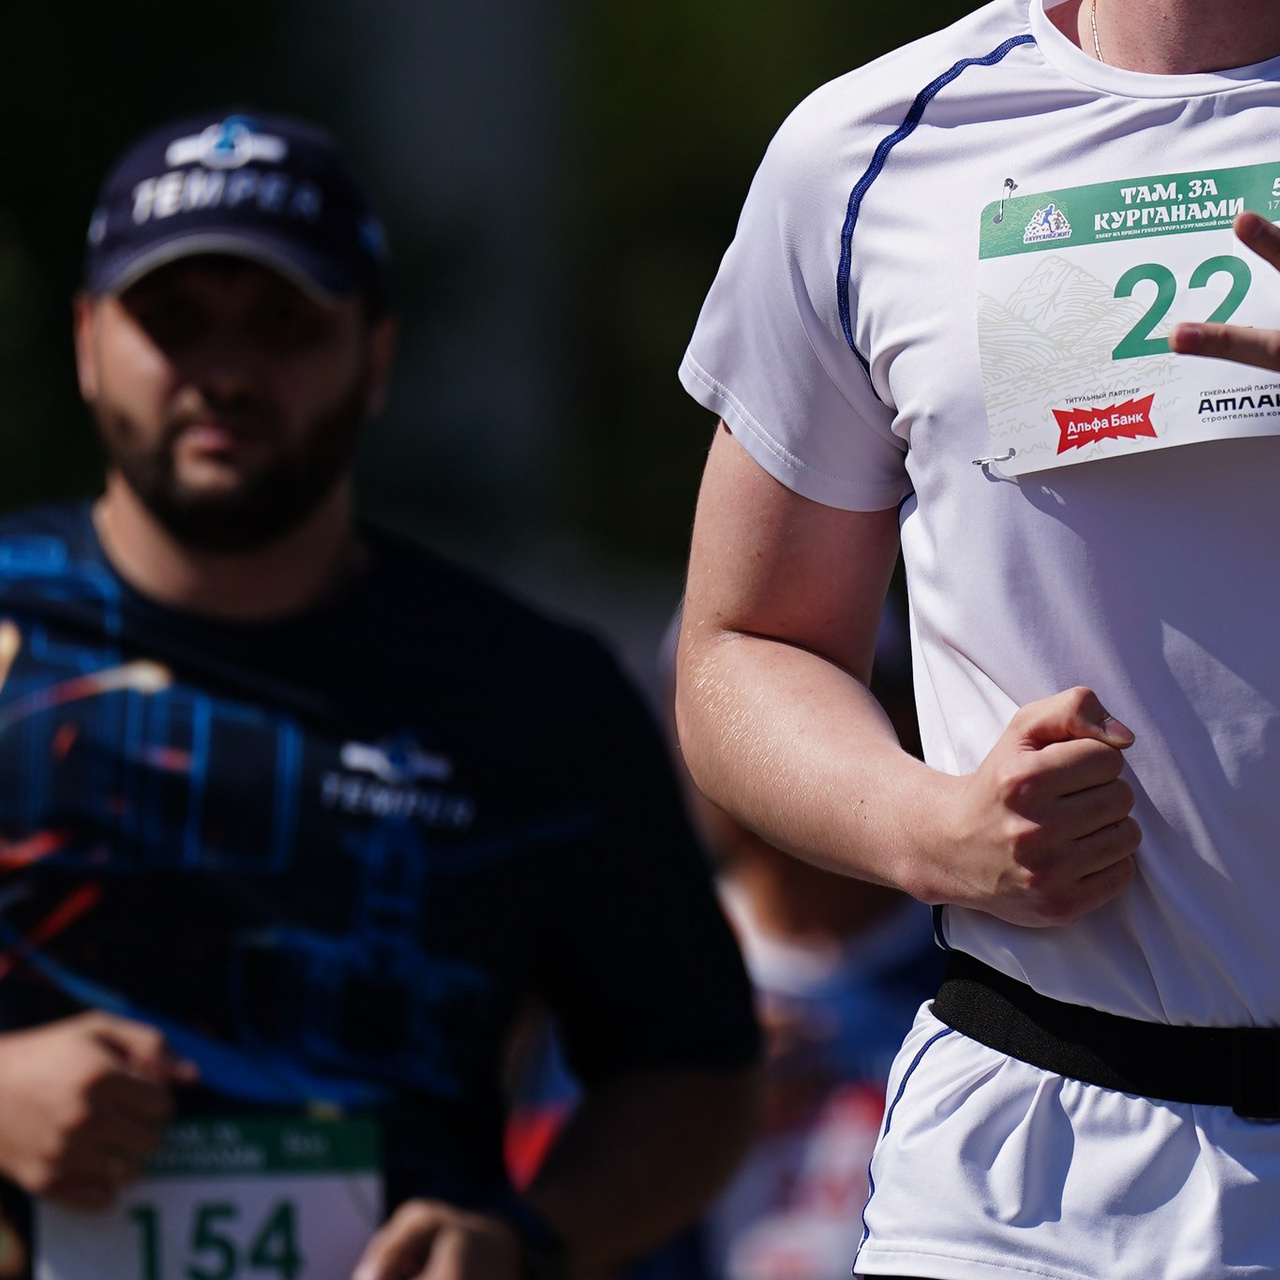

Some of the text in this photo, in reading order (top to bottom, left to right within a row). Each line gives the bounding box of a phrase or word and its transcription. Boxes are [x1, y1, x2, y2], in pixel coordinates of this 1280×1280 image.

[1120, 179, 1218, 205] ТАМ, ЗА
[1094, 197, 1245, 231] КУРГАНАМИ
[1112, 255, 1252, 360] 22
[1065, 387, 1141, 404] ТИТУЛЬНЫЙ ПАРТНЕР
[1200, 385, 1253, 397] ГЕНЕРАЛЬНЫЙ
[1067, 412, 1144, 435] Альфа Банк
[1201, 411, 1265, 423] строительная
